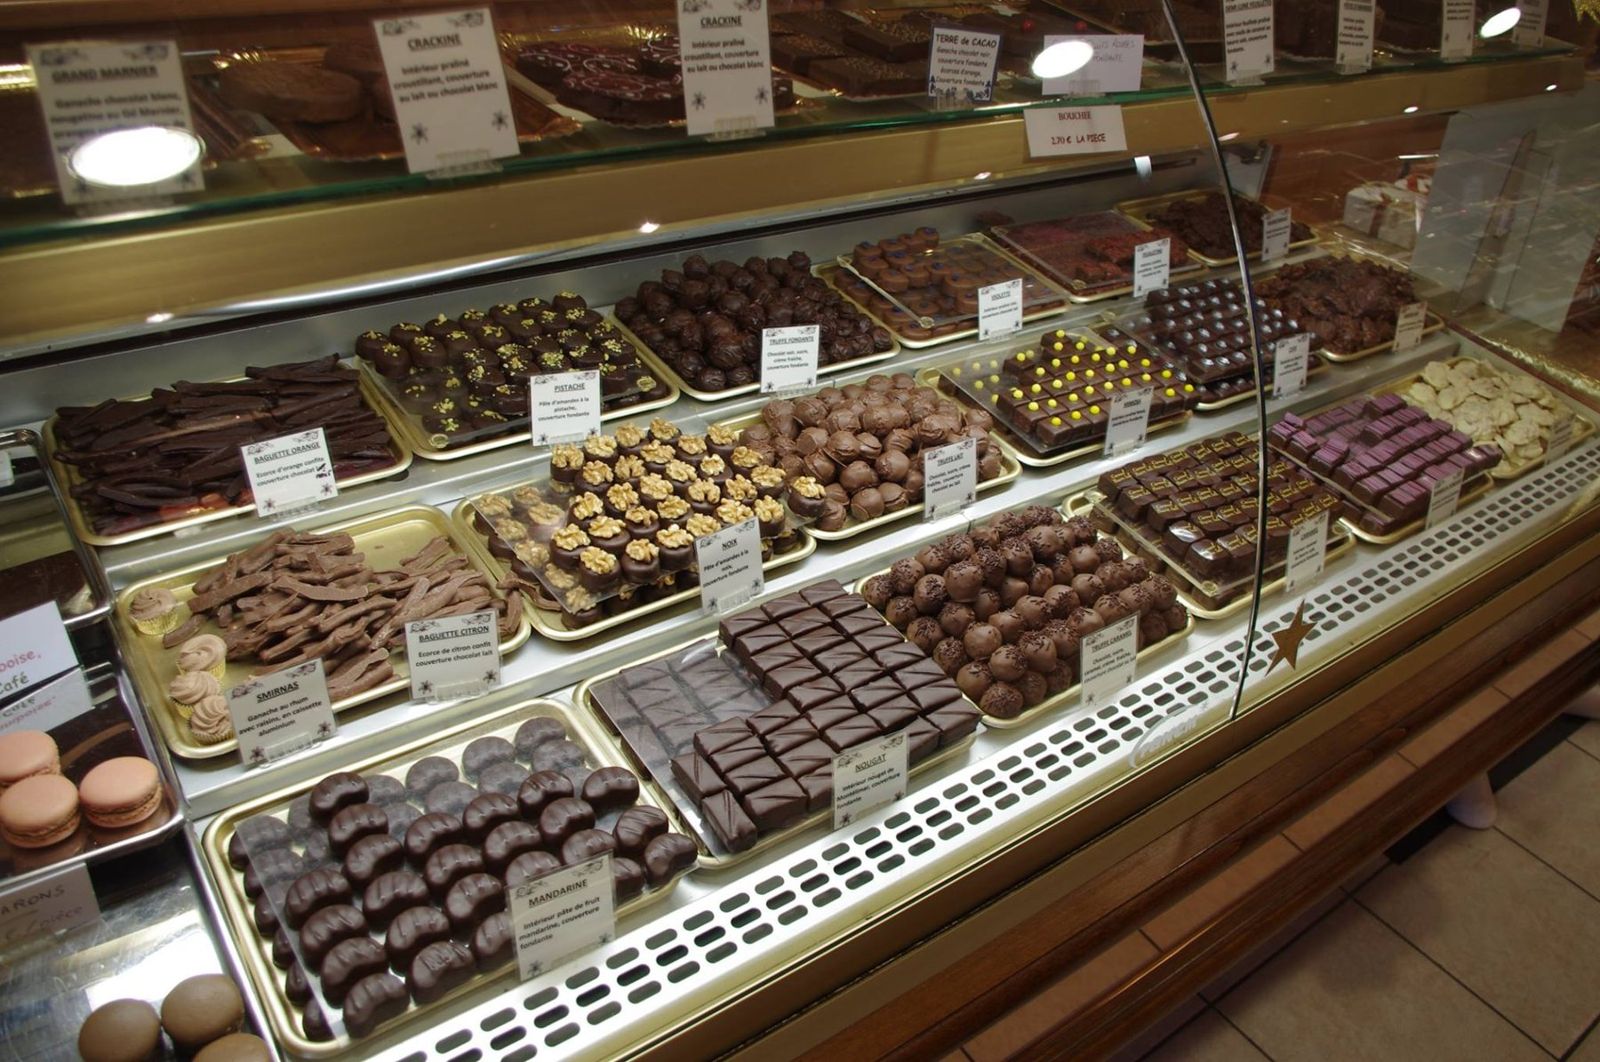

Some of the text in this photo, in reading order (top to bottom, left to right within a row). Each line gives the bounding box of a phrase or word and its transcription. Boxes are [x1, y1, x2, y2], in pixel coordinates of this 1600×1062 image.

[700, 15, 743, 28] CRACKINE
[407, 33, 463, 52] CRACKINE
[692, 38, 745, 49] Intérieur praliné
[936, 33, 997, 49] TERRE de CACAO
[724, 50, 759, 59] couverture
[697, 63, 707, 72] lait
[719, 61, 746, 71] chocolat
[747, 58, 764, 68] blanc
[52, 65, 159, 85] GRAND MARNIER
[446, 69, 491, 83] couverture
[440, 85, 475, 97] chocolat
[477, 80, 498, 91] blanc
[1066, 136, 1072, 145] €
[1076, 135, 1086, 144] LA
[554, 382, 586, 393] PISTACHE
[254, 442, 321, 465] BAGUETTE ORANGE
[257, 467, 316, 487] couverture chocolat
[722, 539, 737, 551] NOIX
[418, 626, 490, 643] BAGUETTE CITRON
[1110, 631, 1132, 643] CARAMEL
[418, 641, 491, 658] Ecorce de citron confit
[415, 649, 494, 668] couverture chocolat lait
[256, 681, 300, 704] SMIRNAS
[239, 701, 322, 735] avec raisins, en caissette
[247, 706, 278, 722] Ganache
[290, 697, 309, 708] rhum
[259, 720, 297, 737] aluminium
[855, 753, 887, 773] NOUGAT
[871, 773, 901, 788] couverture
[528, 879, 588, 908] MANDARINE
[523, 896, 601, 930] Intérieur pâte de fruit
[519, 905, 600, 941] mandarine, couverture
[519, 933, 553, 951] fondante
